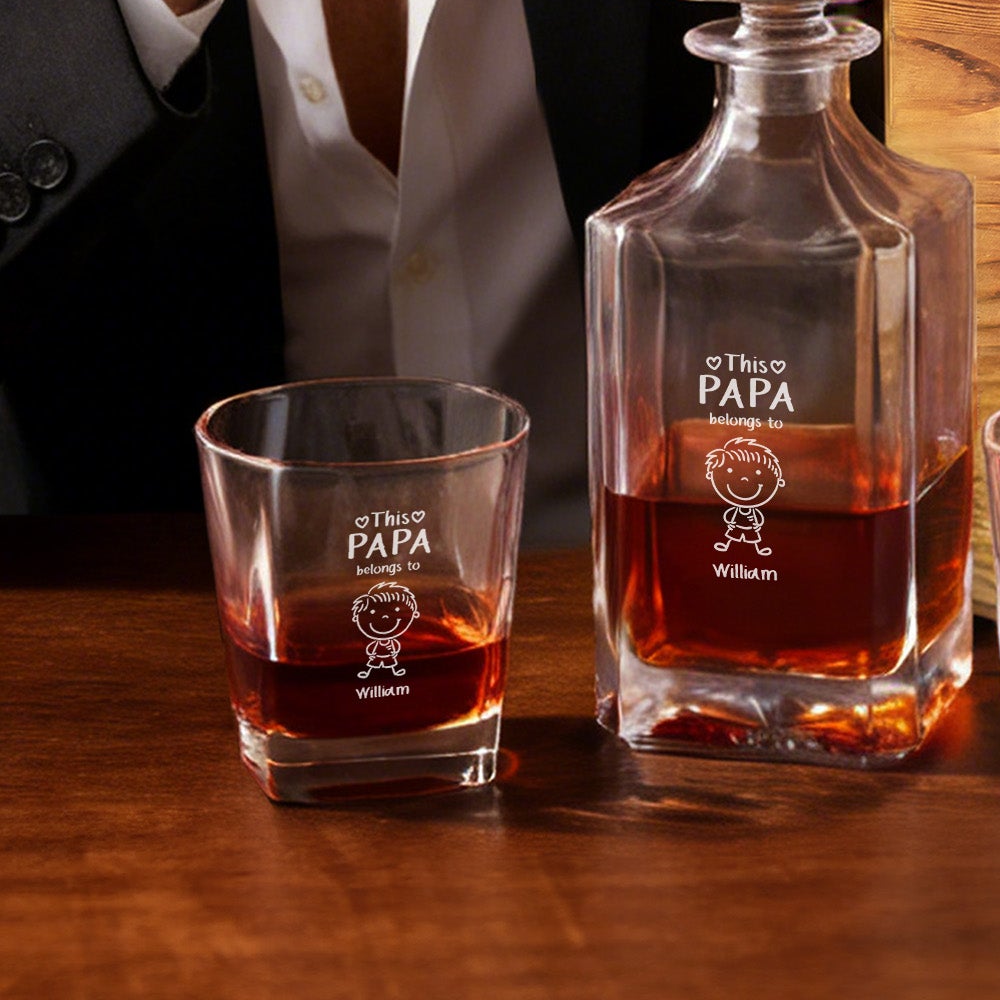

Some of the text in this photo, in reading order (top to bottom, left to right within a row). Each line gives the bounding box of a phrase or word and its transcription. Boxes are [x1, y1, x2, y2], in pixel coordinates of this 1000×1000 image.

[724, 353, 768, 374] This
[698, 374, 795, 413] PAPA
[709, 412, 784, 431] belongs to
[370, 510, 410, 528] This
[347, 528, 431, 560] PAPA
[356, 560, 421, 576] belongs to
[712, 563, 778, 581] William
[355, 685, 410, 700] William
